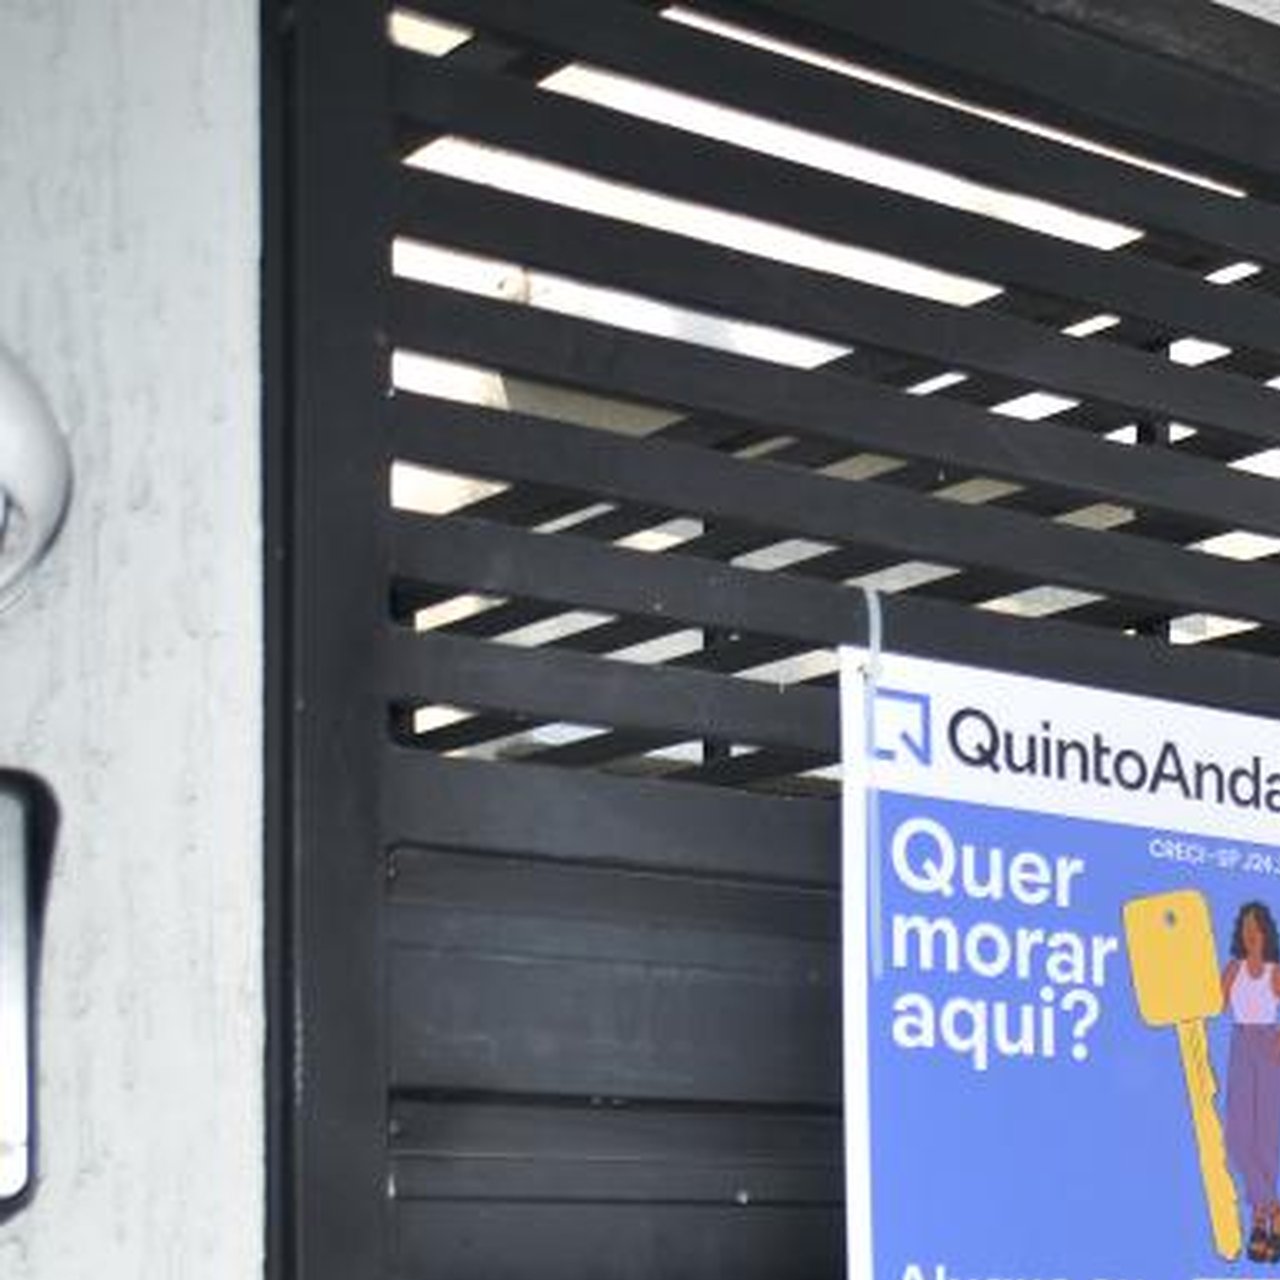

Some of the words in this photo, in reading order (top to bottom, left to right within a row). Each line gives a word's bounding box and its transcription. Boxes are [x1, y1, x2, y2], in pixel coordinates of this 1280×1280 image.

[891, 817, 1084, 907] Quer
[892, 914, 1119, 986] morar
[891, 987, 1100, 1071] aqui?
